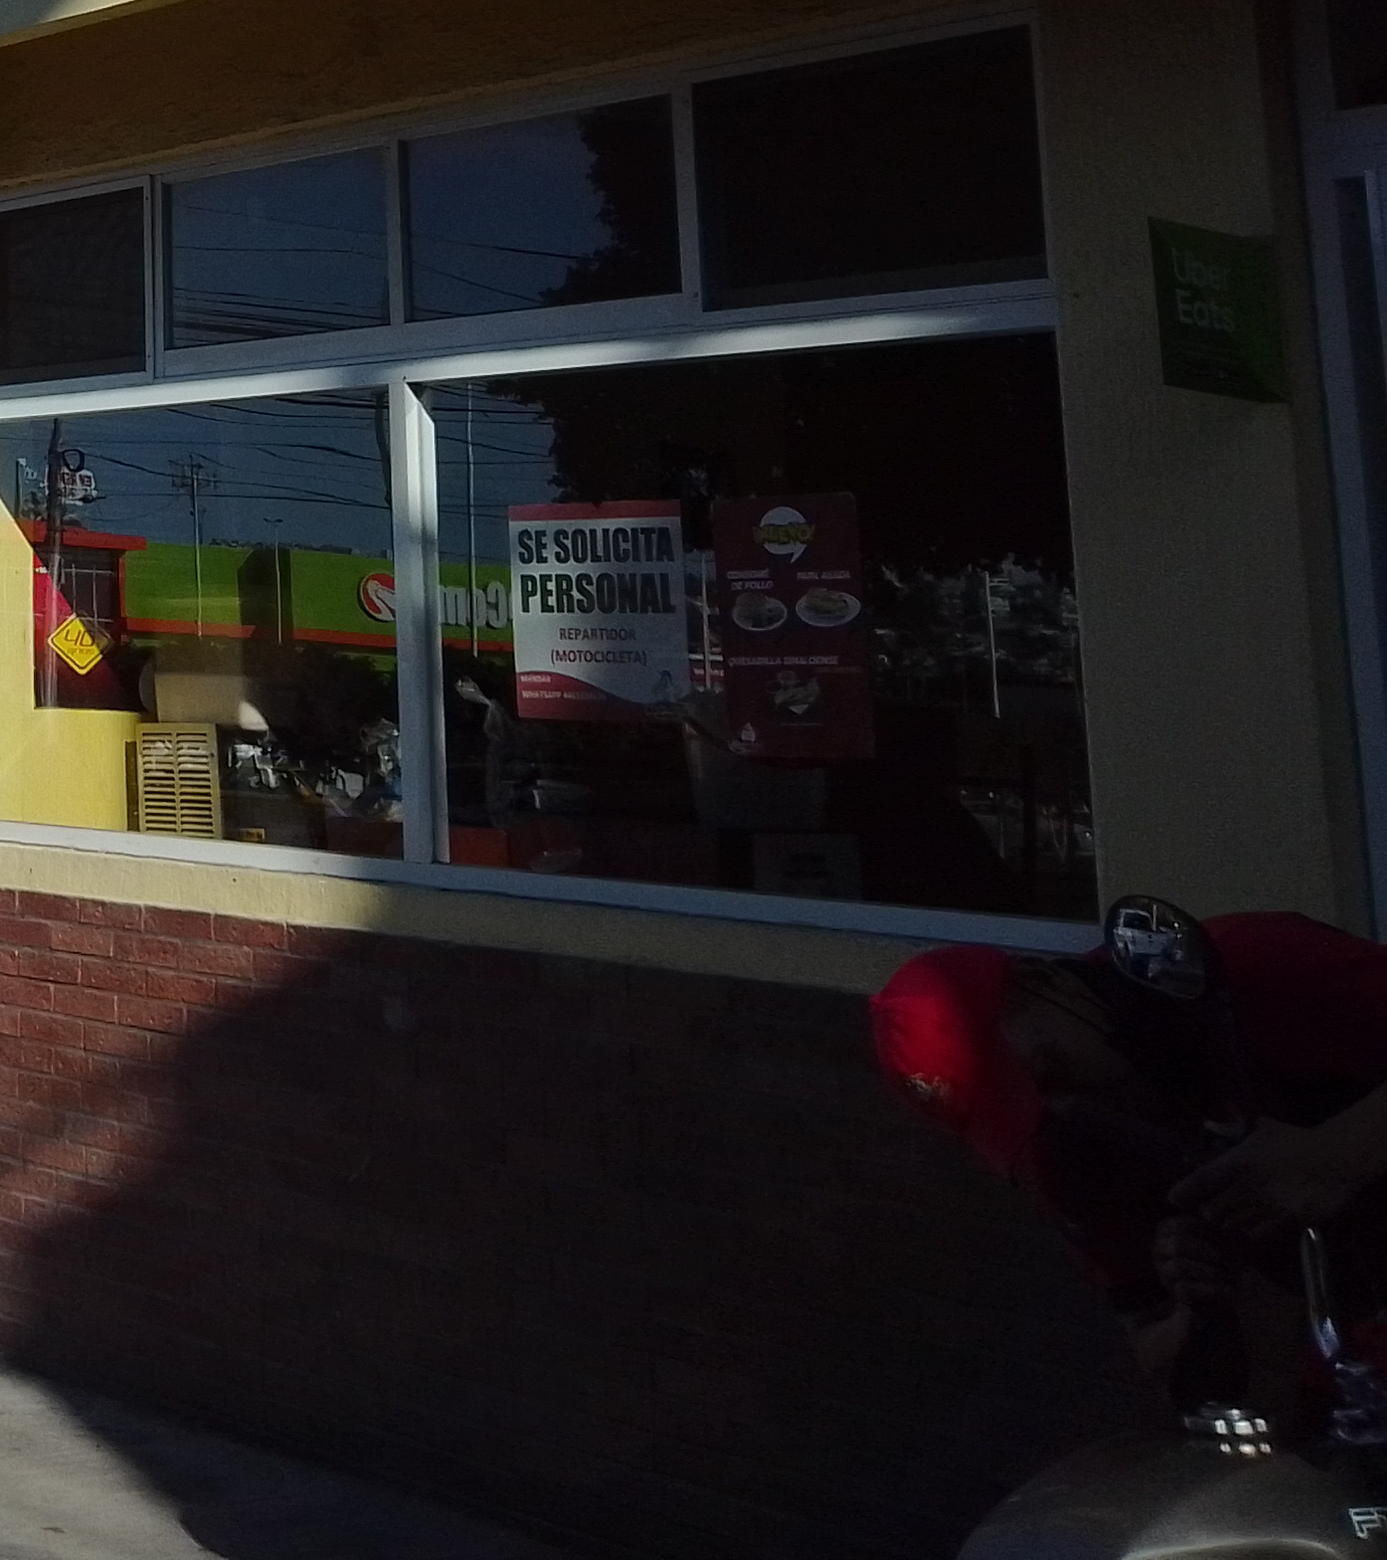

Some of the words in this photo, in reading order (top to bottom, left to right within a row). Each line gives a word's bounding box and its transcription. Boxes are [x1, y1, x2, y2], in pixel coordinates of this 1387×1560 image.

[1175, 288, 1237, 334] Eats
[518, 529, 548, 564] SE
[553, 527, 675, 564] SOLICITA
[520, 572, 676, 614] PERSONAL
[559, 628, 636, 641] REPARTIDOR
[551, 648, 648, 667] (MOTOCICLETA)
